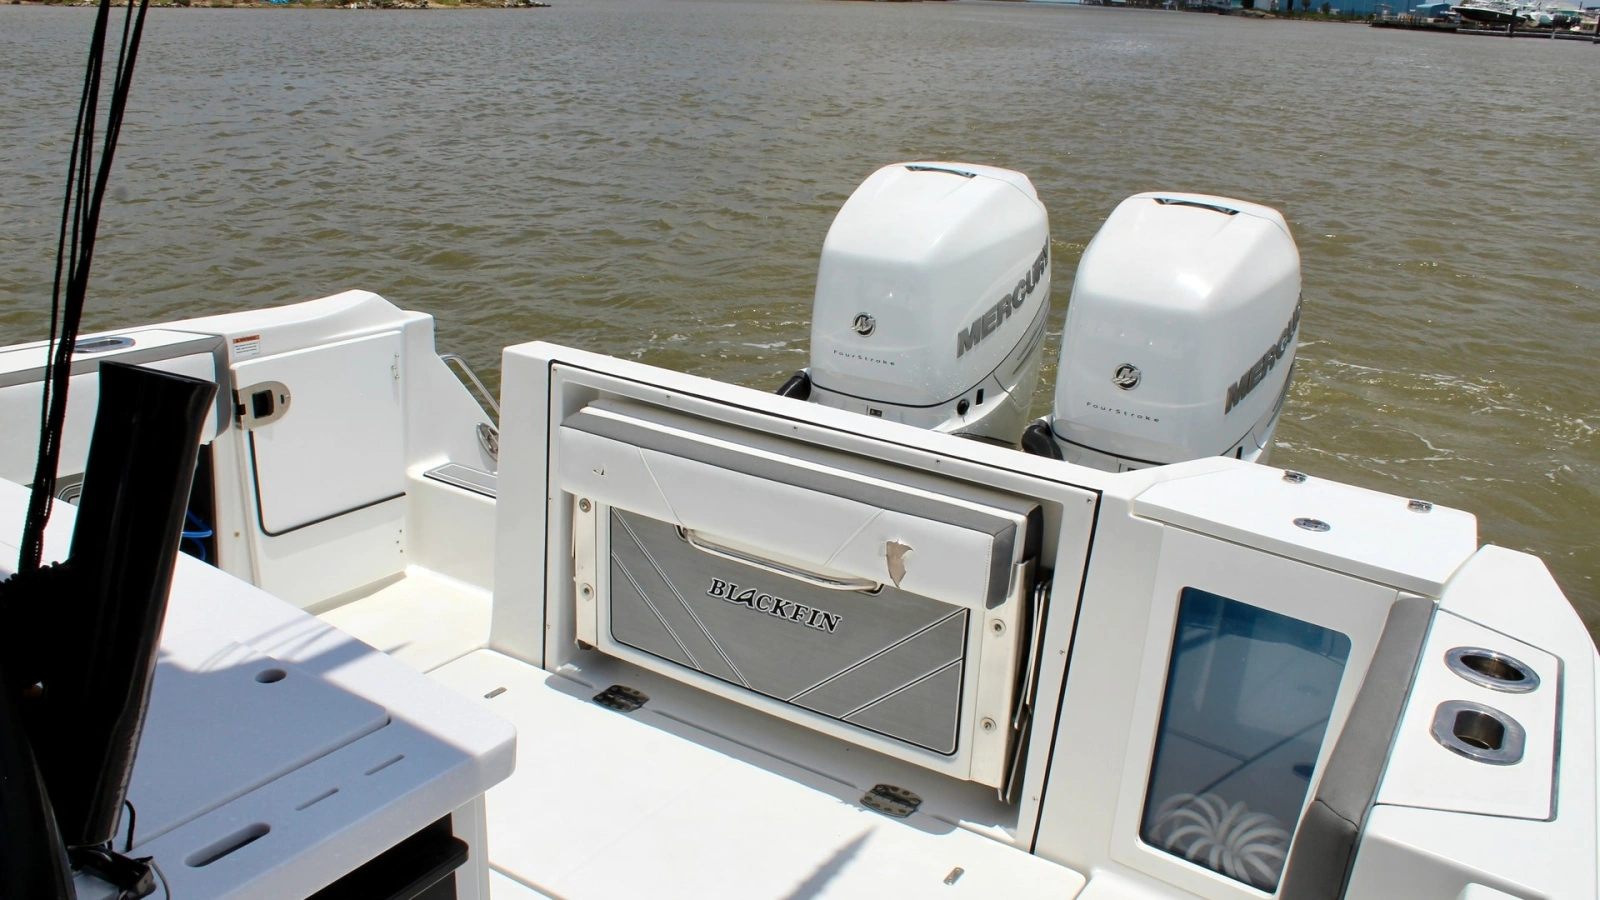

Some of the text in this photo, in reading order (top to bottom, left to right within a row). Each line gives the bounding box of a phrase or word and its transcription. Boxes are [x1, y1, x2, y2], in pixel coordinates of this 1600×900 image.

[833, 349, 896, 366] FourStroke
[1086, 401, 1160, 423] FourStroke
[707, 577, 842, 634] BLACKFIN
